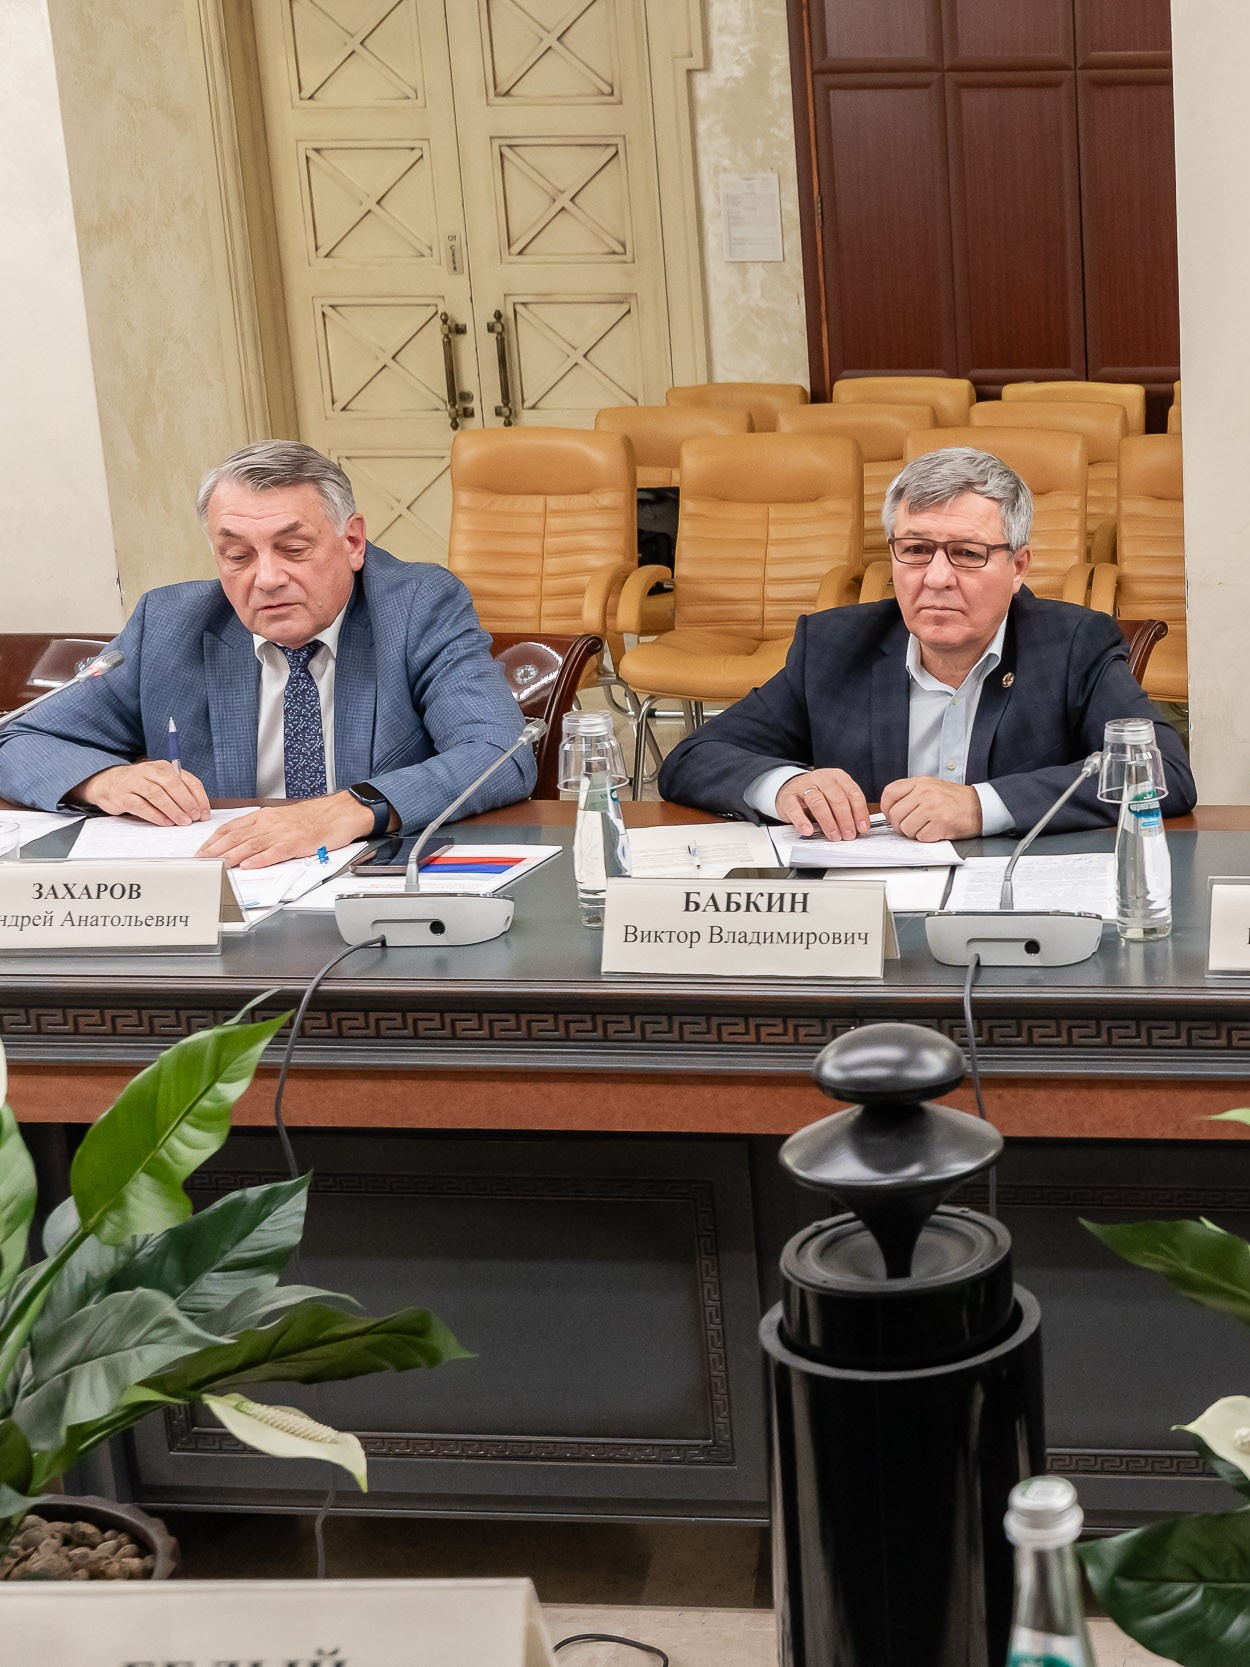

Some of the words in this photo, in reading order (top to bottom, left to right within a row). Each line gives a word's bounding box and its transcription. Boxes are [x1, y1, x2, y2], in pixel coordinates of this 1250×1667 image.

[32, 882, 142, 900] ЗАХАРОВ
[683, 891, 810, 913] БАБКИН
[0, 910, 53, 931] ндрей
[61, 910, 190, 927] Анатольевич
[623, 924, 701, 948] Виктор
[708, 925, 869, 949] Владимирович
